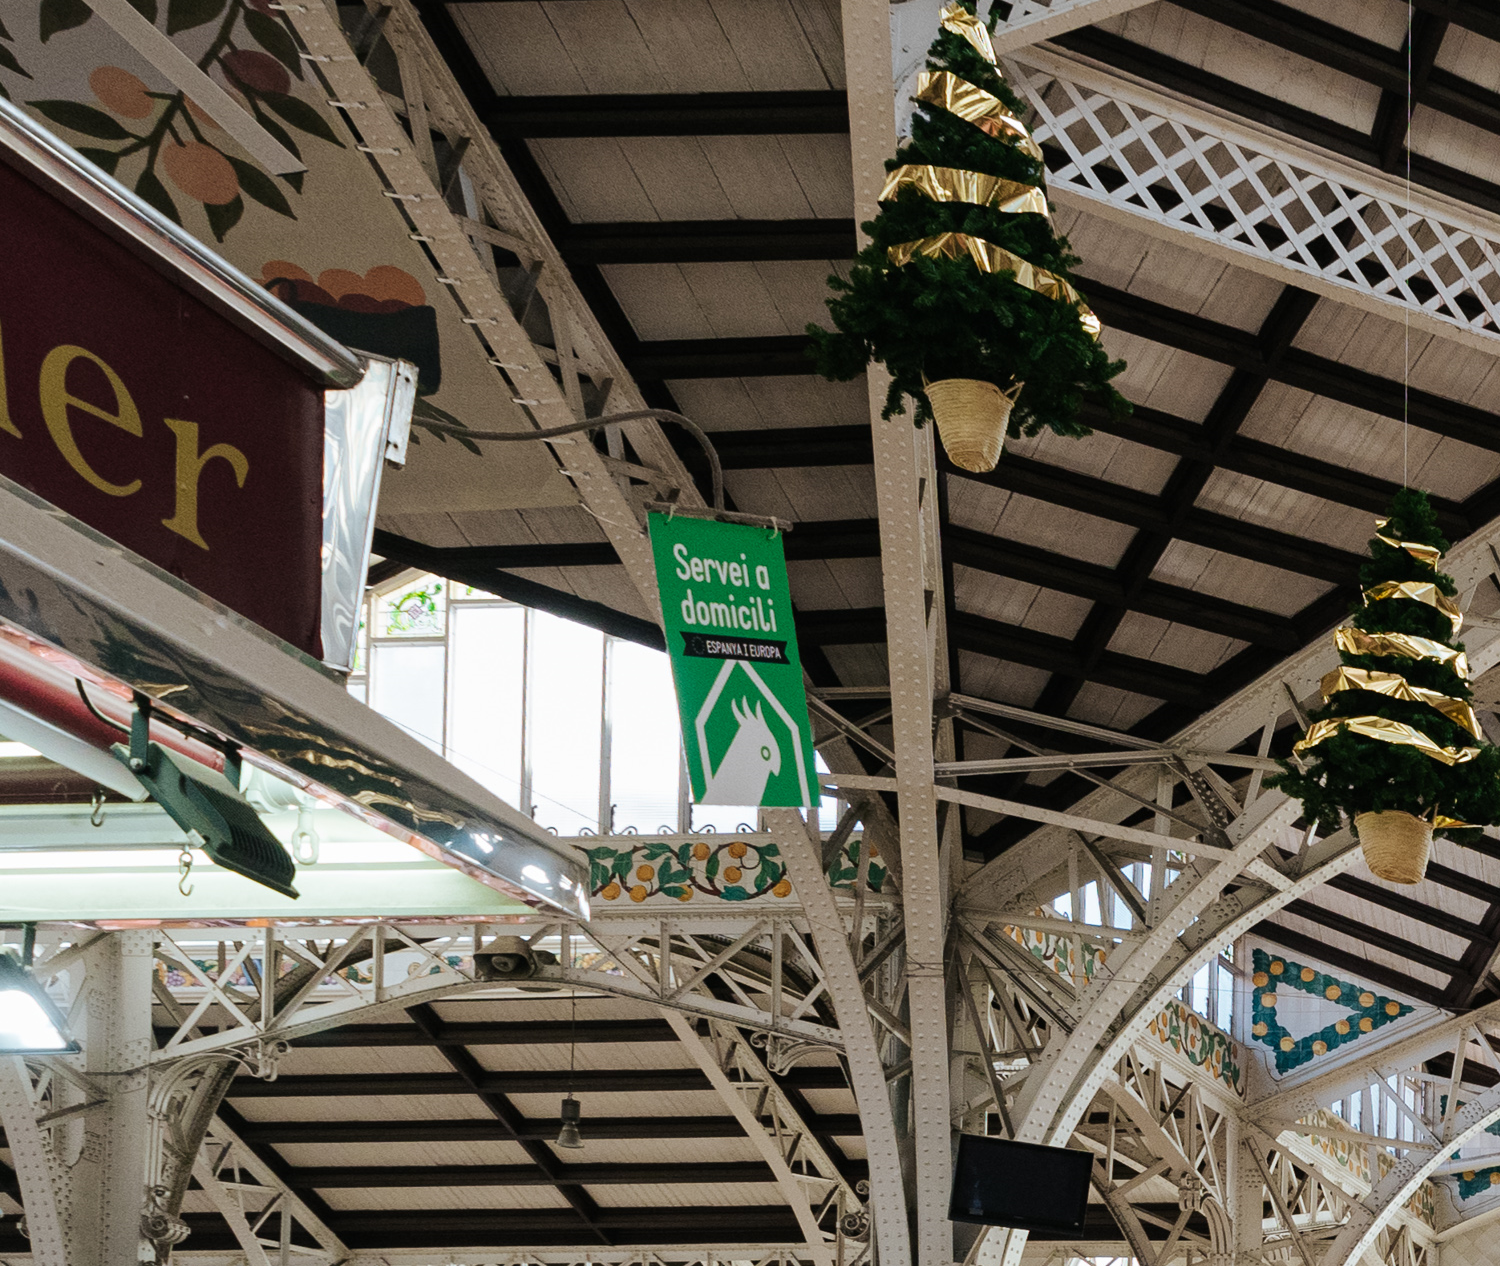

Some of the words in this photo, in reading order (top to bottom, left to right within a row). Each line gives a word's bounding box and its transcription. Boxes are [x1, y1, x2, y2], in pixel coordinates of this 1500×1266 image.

[0, 322, 249, 551] er
[673, 543, 750, 588] Servei
[755, 565, 770, 590] a
[681, 588, 777, 633] domicili
[706, 640, 742, 655] ESPANYA
[750, 647, 782, 659] EUROPA
